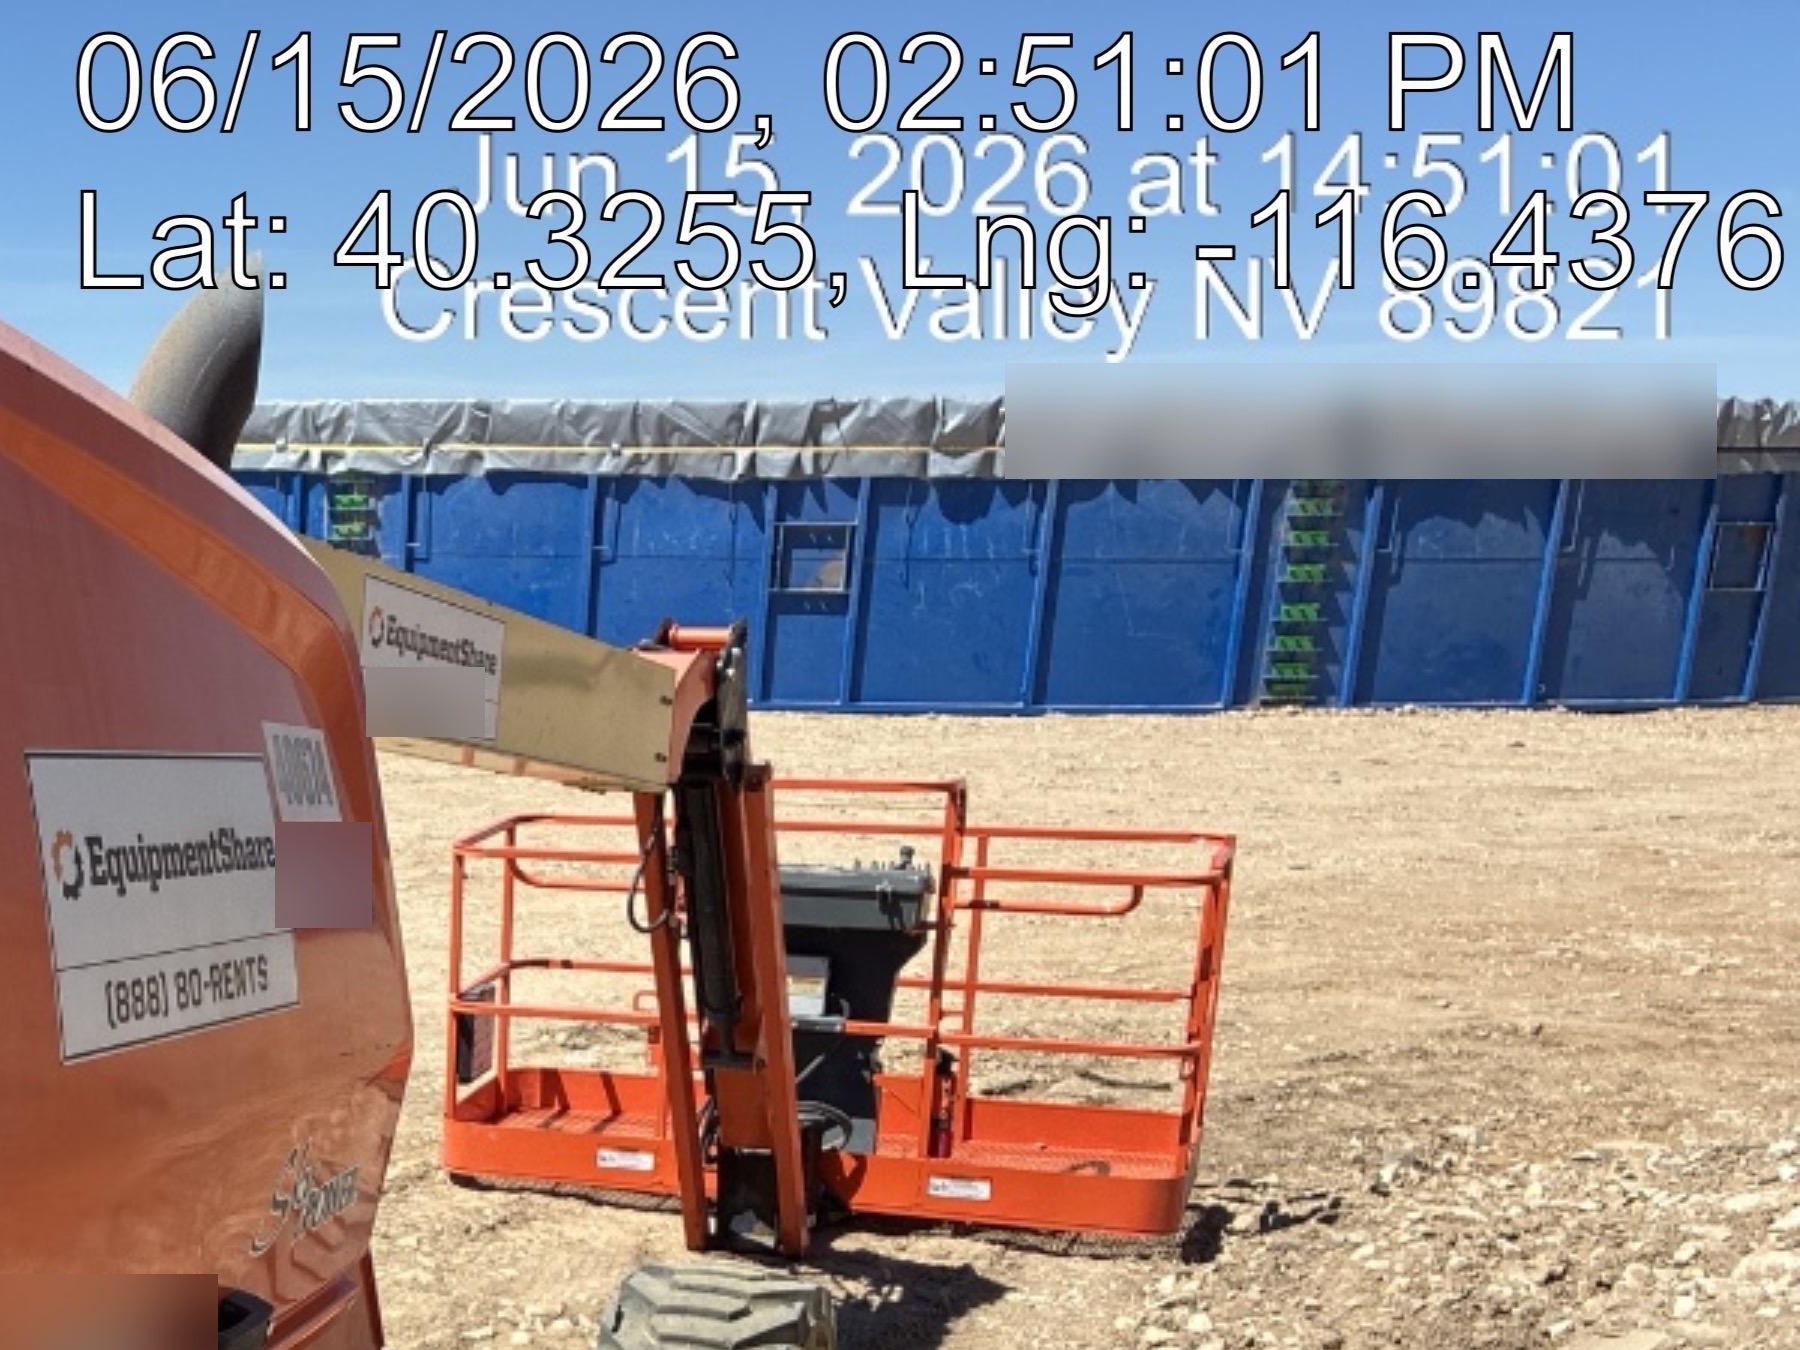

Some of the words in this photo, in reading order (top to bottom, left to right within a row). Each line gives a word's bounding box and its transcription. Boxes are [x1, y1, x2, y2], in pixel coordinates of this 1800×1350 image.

[386, 614, 497, 676] EquipmentShare
[86, 828, 275, 896] EquipmentShare
[104, 971, 169, 1029] (888)
[174, 954, 268, 1010] 80-RENTS
